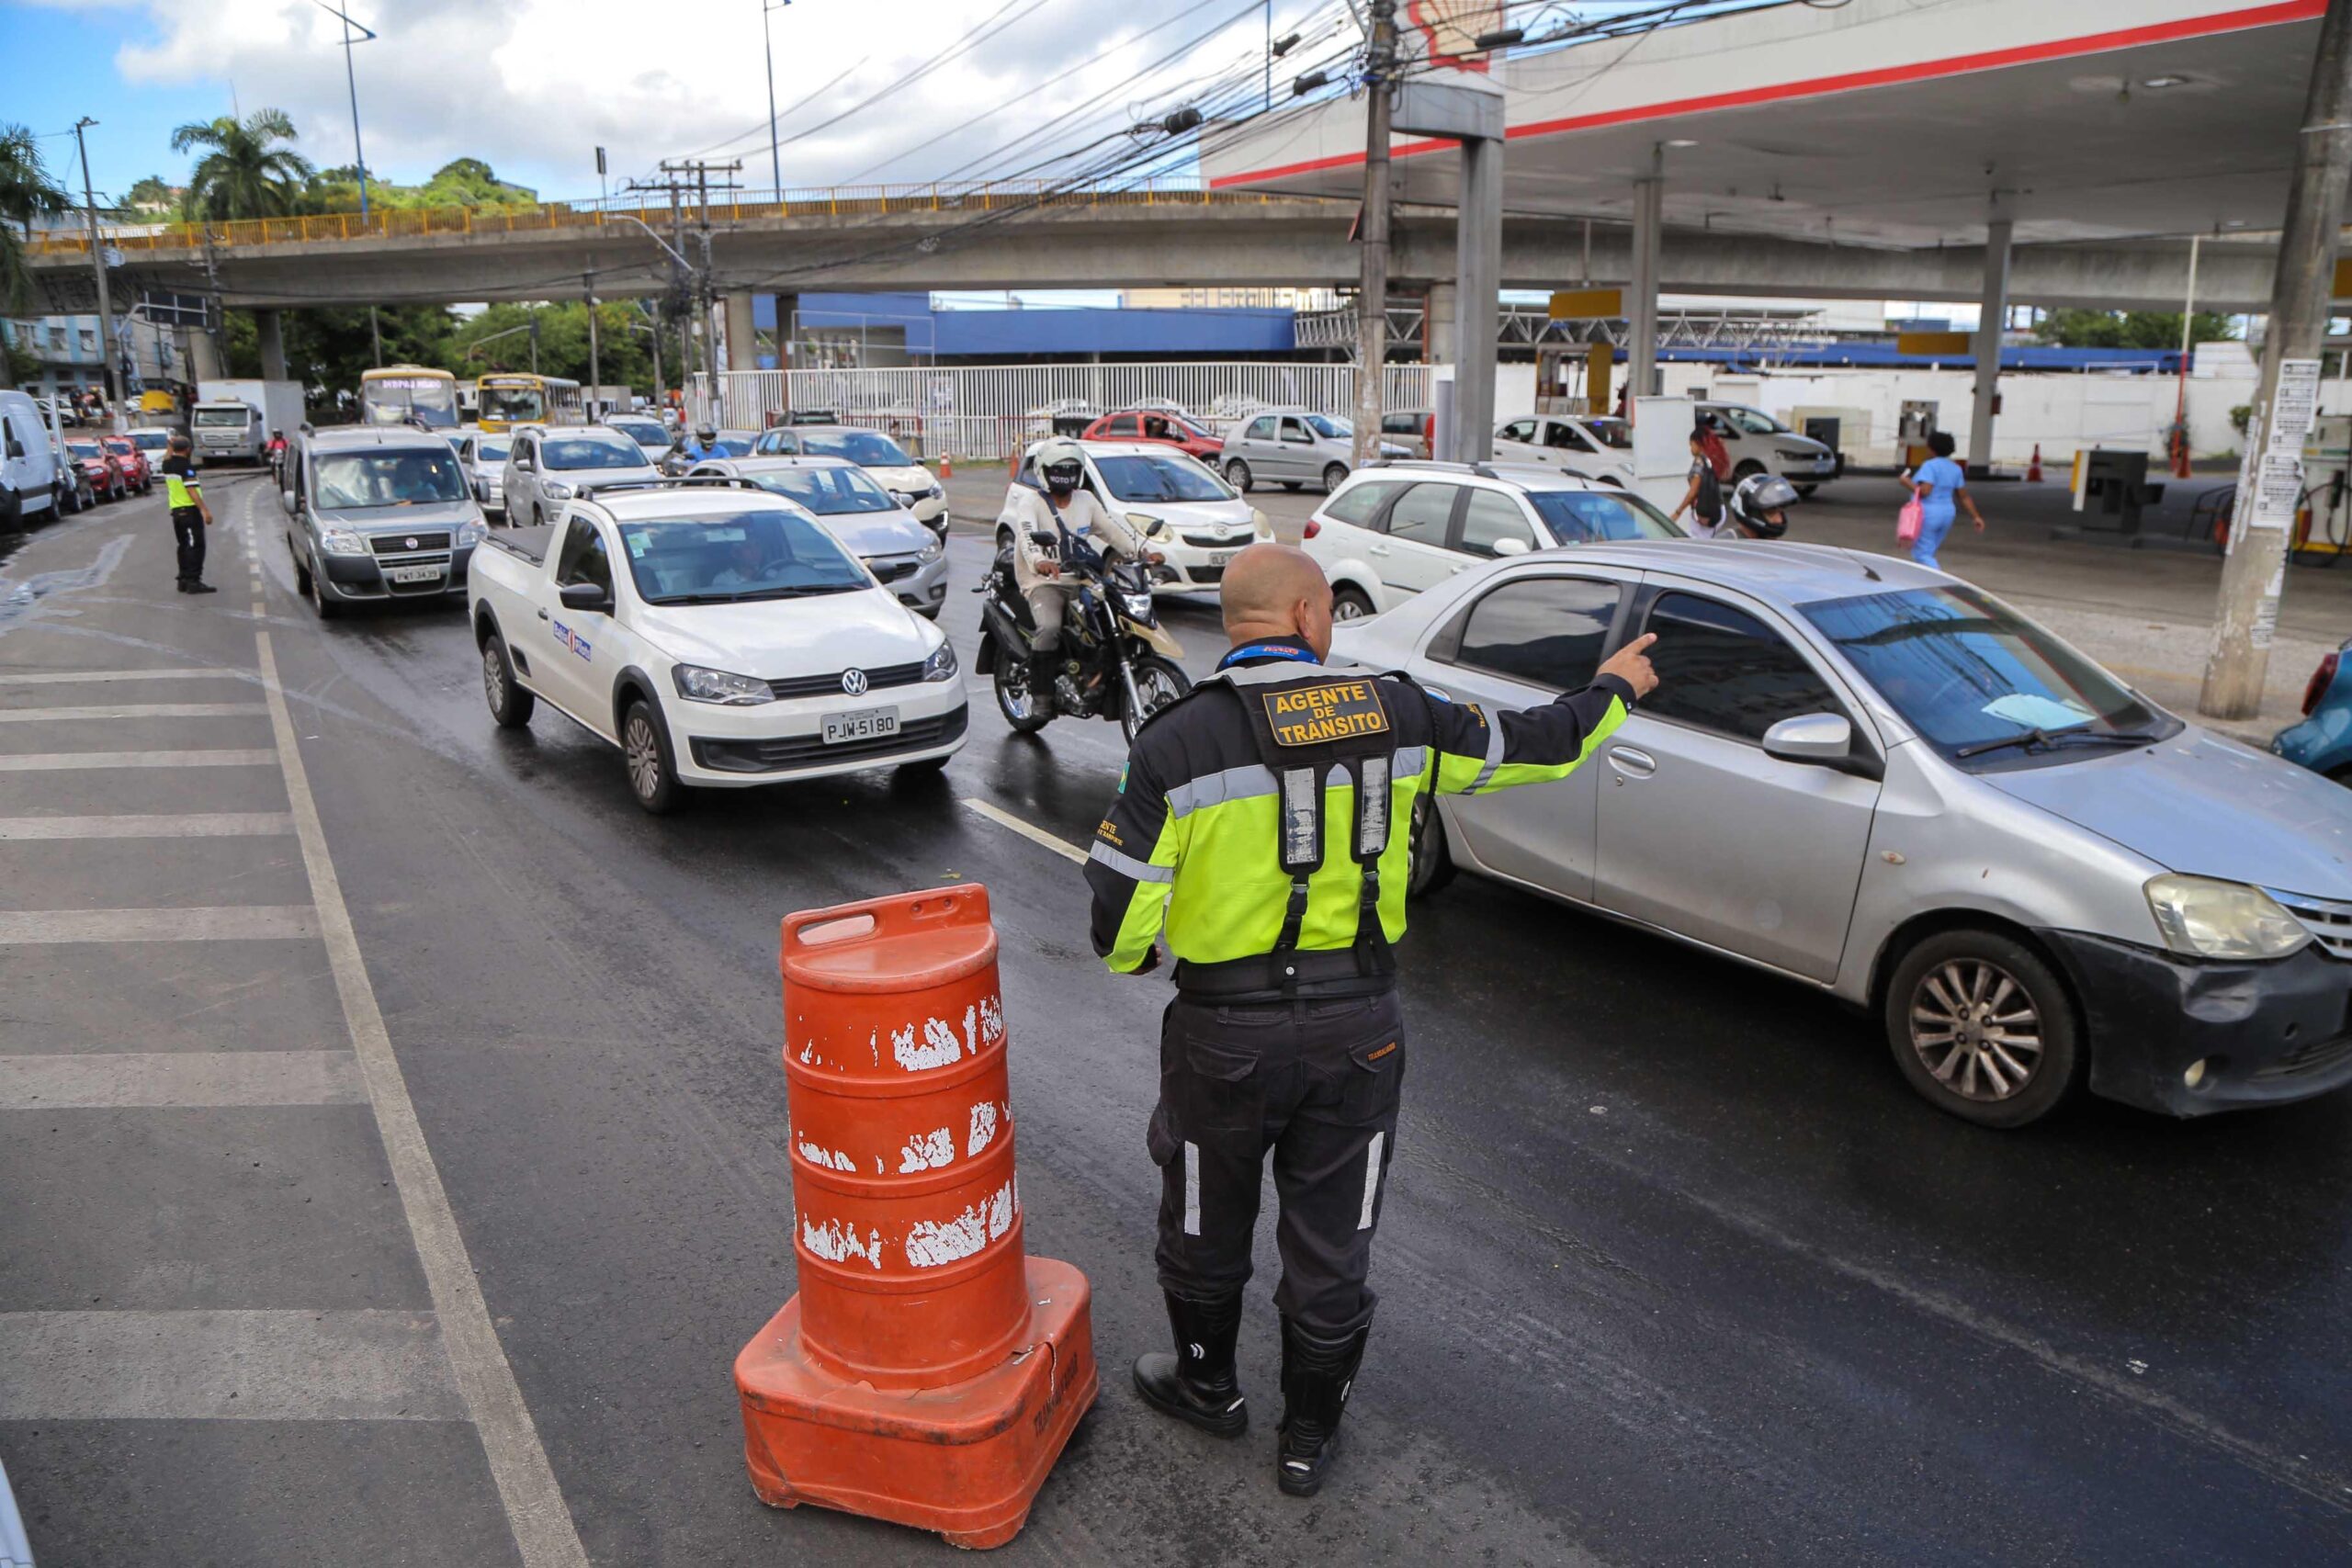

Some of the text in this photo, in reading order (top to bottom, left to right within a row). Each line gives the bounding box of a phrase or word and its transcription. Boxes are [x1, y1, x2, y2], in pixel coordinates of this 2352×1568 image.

[1276, 685, 1368, 714] AGENTE
[1313, 705, 1336, 719] DE
[1278, 712, 1382, 743] TRÂNSITO
